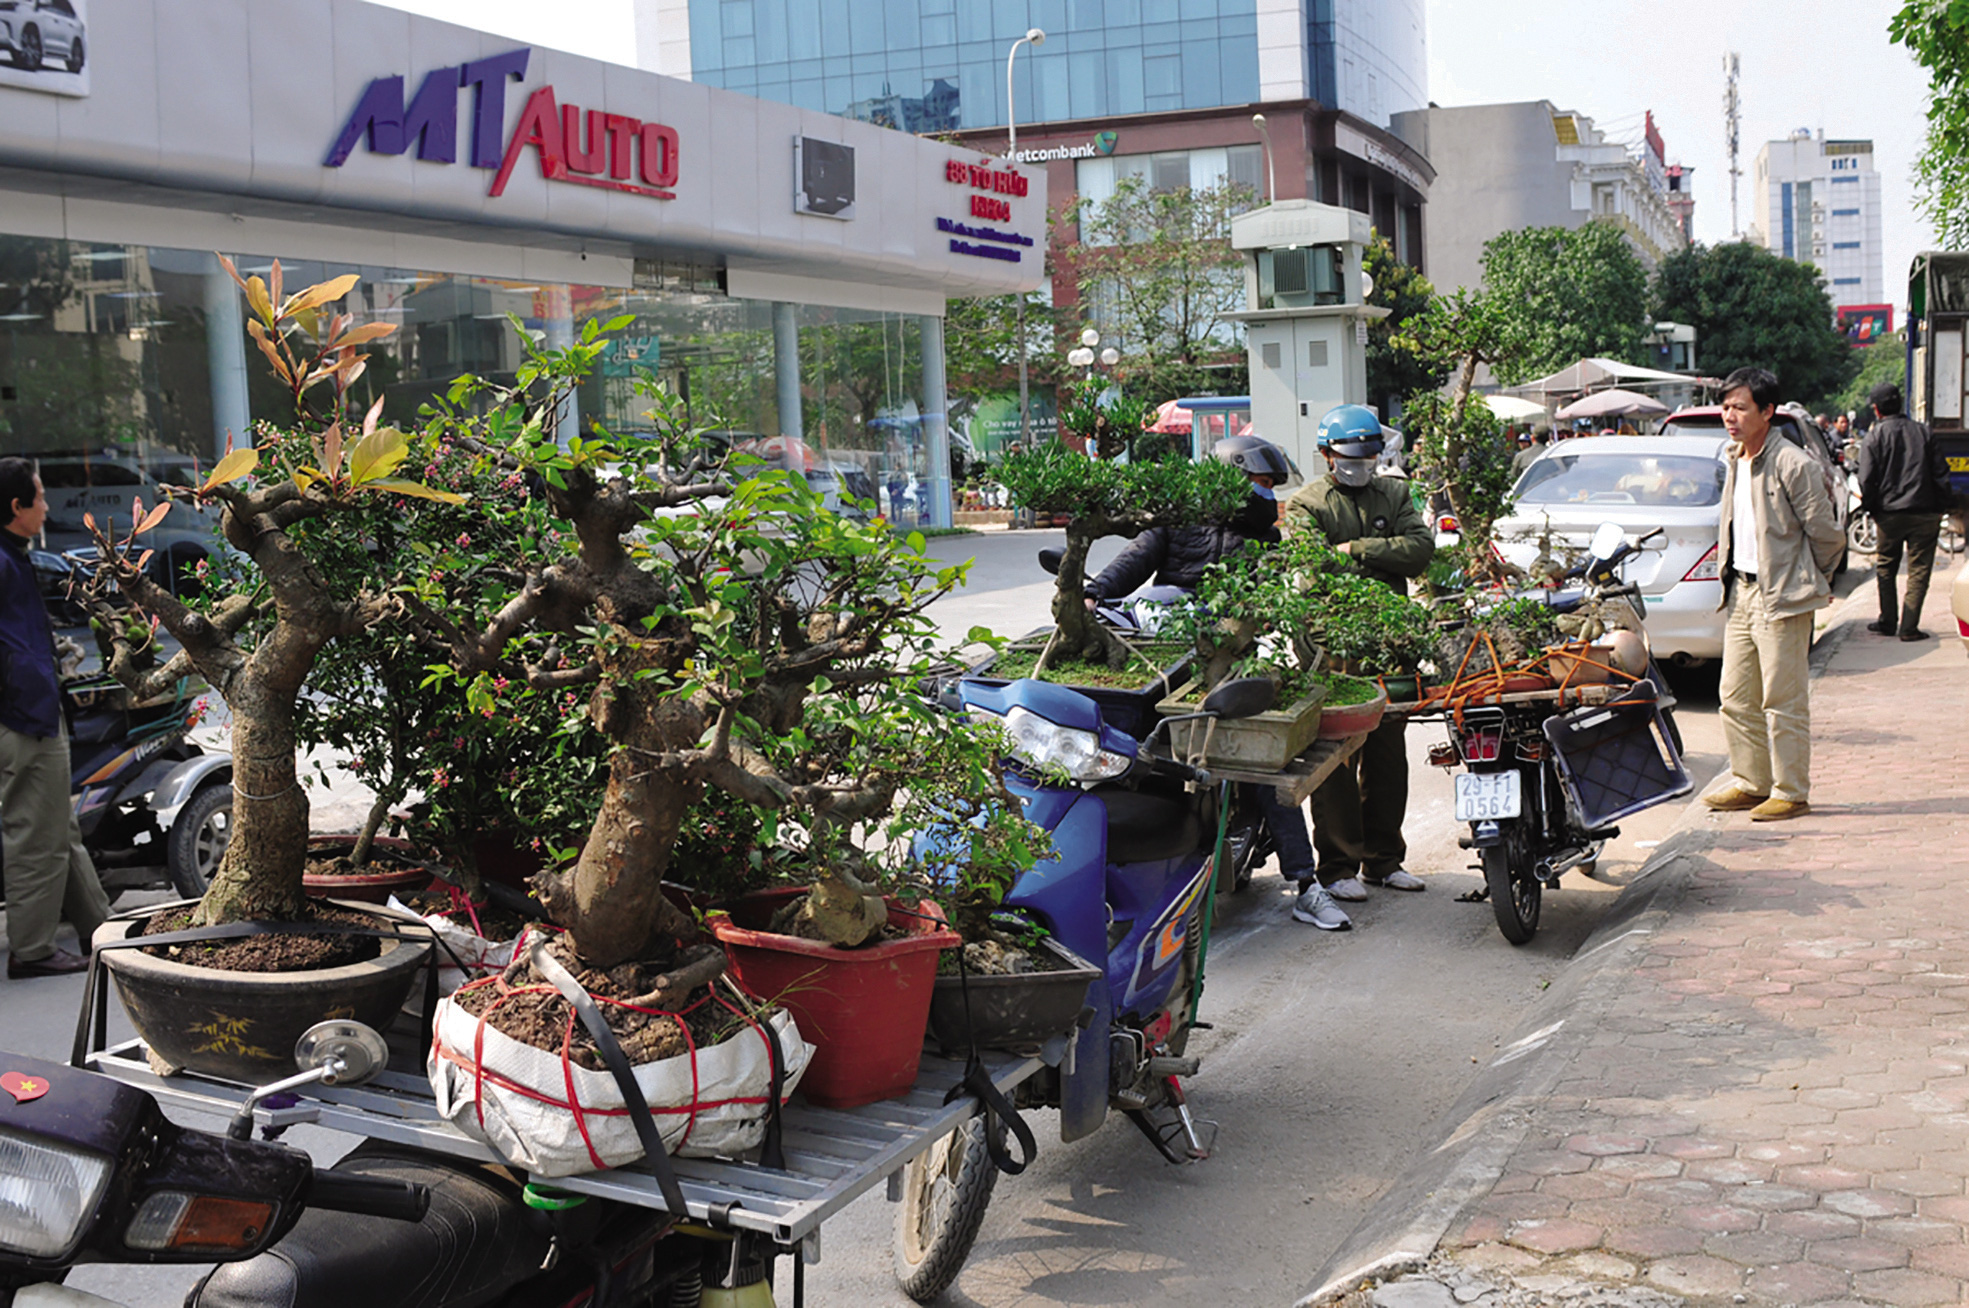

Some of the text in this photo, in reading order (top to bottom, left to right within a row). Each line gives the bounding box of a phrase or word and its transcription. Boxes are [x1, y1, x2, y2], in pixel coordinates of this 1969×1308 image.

[322, 47, 679, 199] MT AUTO
[1001, 142, 1096, 162] Vetcombank
[946, 160, 969, 184] 88
[982, 420, 999, 428] Cho
[1465, 795, 1511, 818] 0564
